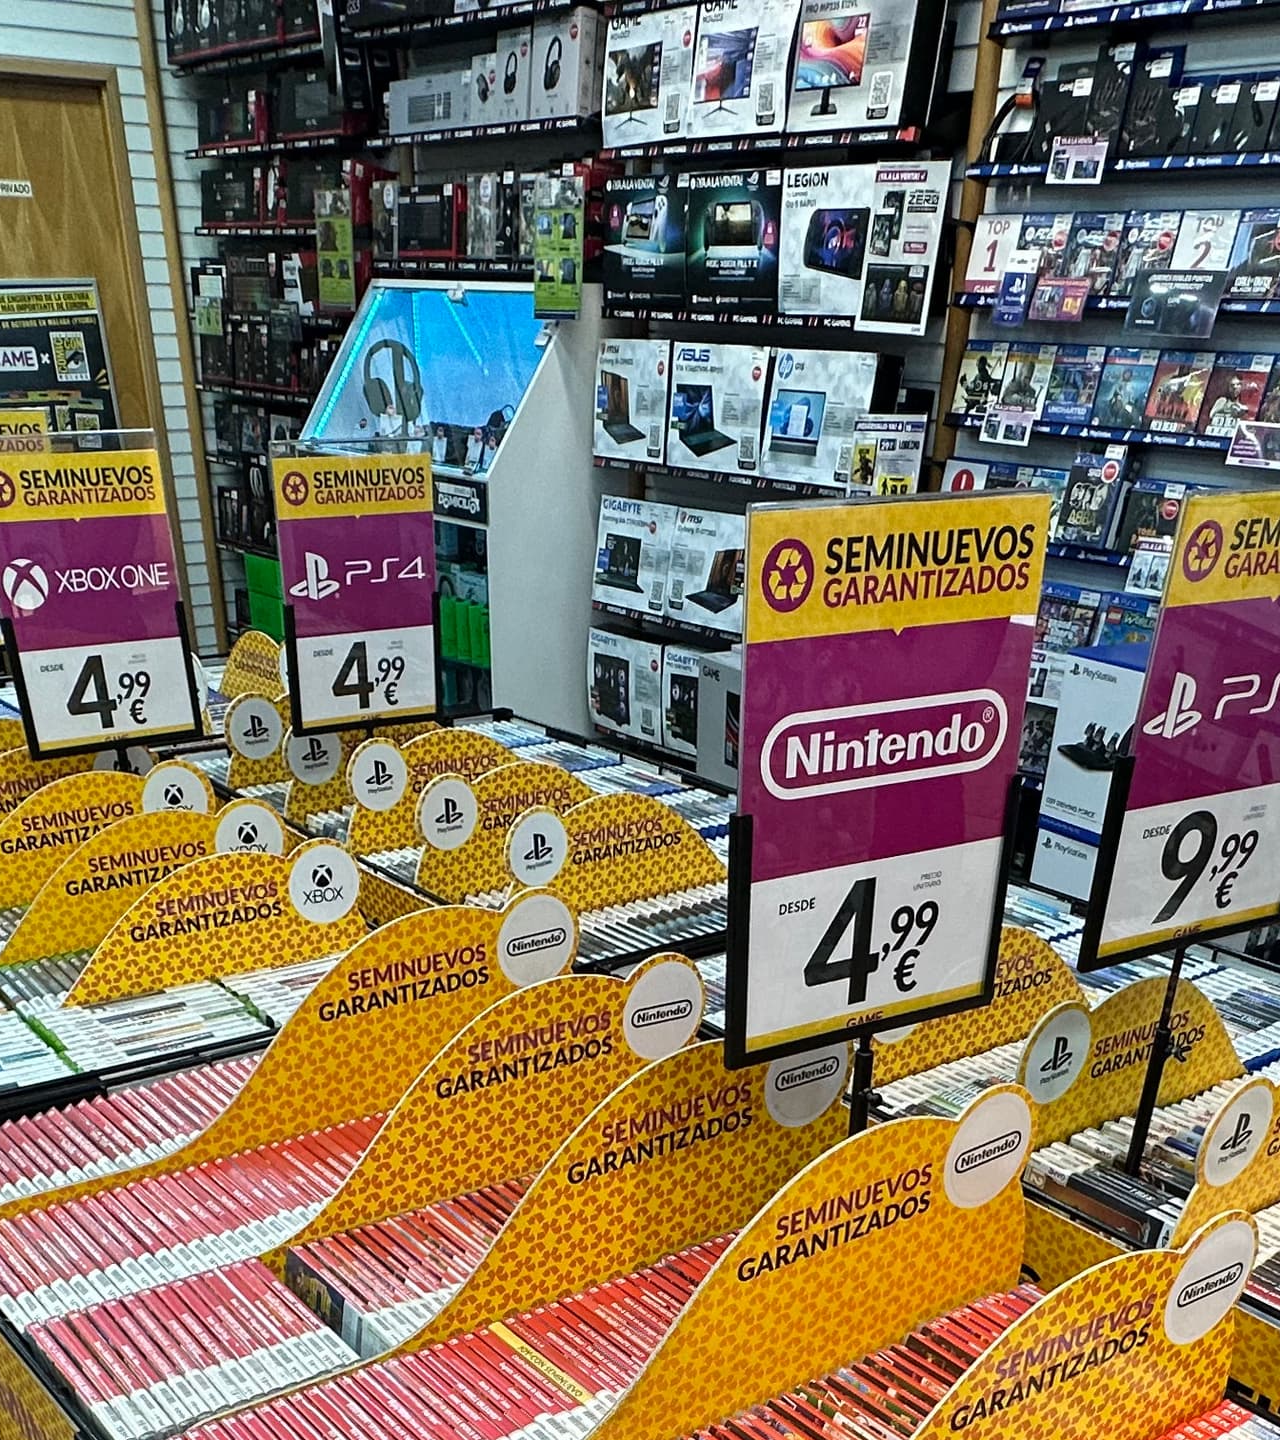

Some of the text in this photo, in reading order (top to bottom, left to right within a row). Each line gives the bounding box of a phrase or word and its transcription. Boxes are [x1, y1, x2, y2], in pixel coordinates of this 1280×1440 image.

[786, 172, 829, 188] LEGION
[986, 219, 1011, 236] TOP
[984, 240, 1000, 272] 1
[676, 348, 710, 362] ASUS
[19, 466, 153, 489] SEMINUEVOS
[313, 467, 425, 489] SEMINUEVOS
[23, 485, 156, 507] GARANTIZADOS
[314, 485, 425, 505] GARANTIZADOS
[603, 499, 642, 515] GIGABYTE
[824, 524, 1035, 574] SEMINUEVOS
[55, 563, 170, 593] XBOX ONE
[344, 556, 426, 585] PS4
[823, 563, 1030, 608] GARANTIZADOS
[40, 663, 65, 674] DESDE
[332, 641, 405, 709] 4,99
[67, 655, 151, 729] 4,99
[384, 682, 399, 706] €
[129, 699, 147, 725] €
[785, 713, 985, 779] Nintendo
[412, 753, 498, 778] SEMINUEVOS
[482, 787, 571, 813] SEMINUEVOS
[21, 801, 135, 833] SEMINUEVOS
[572, 816, 663, 847] SEMINUEVOS
[1142, 824, 1173, 839] DESDE
[87, 841, 206, 874] SEMINUEVOS
[572, 832, 682, 865] GARANTIZADOS
[1150, 809, 1259, 925] 9,99
[154, 881, 278, 919] SEMINUEVOS
[302, 887, 344, 904] XBOX
[778, 897, 816, 916] DESDE
[1215, 872, 1238, 908] €
[130, 901, 282, 943] GARANTIZADOS
[511, 929, 563, 954] Nintendo
[803, 877, 939, 1006] 4,99
[347, 942, 487, 993] SEMINUEVOS
[893, 949, 919, 992] €
[319, 965, 489, 1022] GARANTIZADOS
[636, 1000, 689, 1027] Nintendo
[467, 1009, 612, 1065] SEMINUEVOS
[435, 1034, 613, 1099] GARANTIZADOS
[780, 1059, 835, 1088] Nintendo
[601, 1081, 753, 1147] SEMINUEVOS
[567, 1107, 753, 1186] GARANTIZADOS
[959, 1138, 1016, 1172] Nintendo
[774, 1162, 933, 1241] SEMINUEVOS
[737, 1190, 931, 1283] GARANTIZADOS
[1182, 1267, 1240, 1303] Nintendo
[995, 1295, 1156, 1384] SEMINUEVOS
[948, 1322, 1152, 1431] GARANTIZADOS
